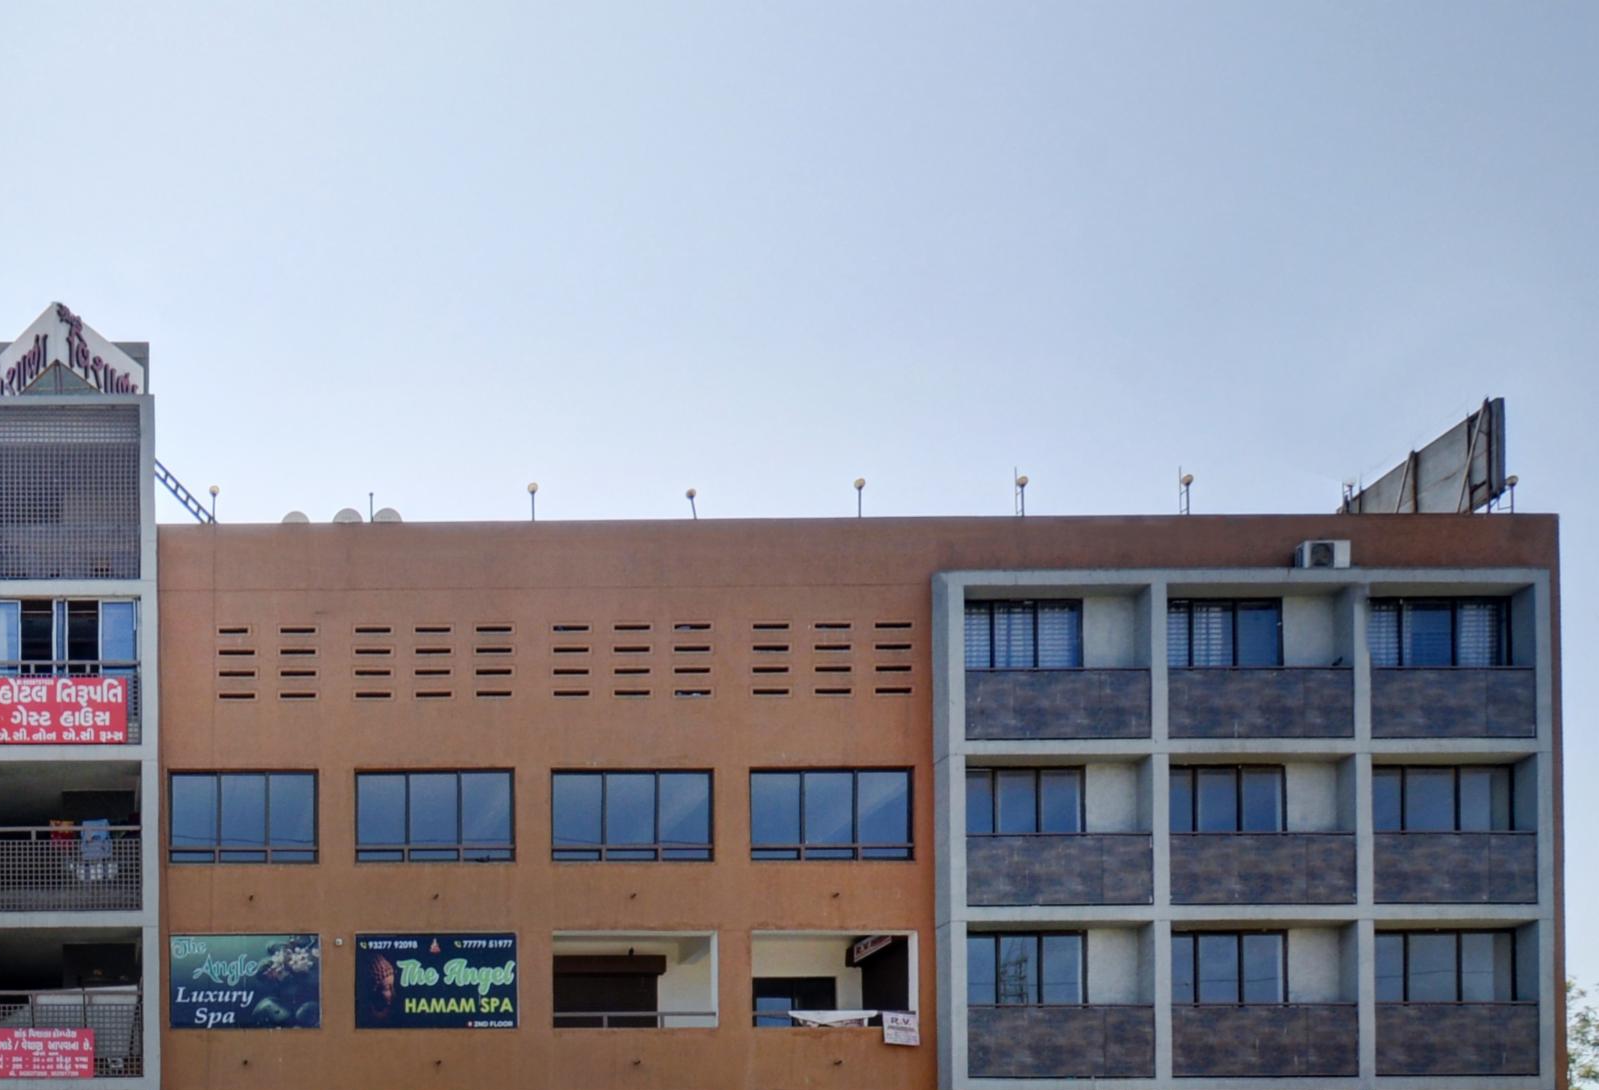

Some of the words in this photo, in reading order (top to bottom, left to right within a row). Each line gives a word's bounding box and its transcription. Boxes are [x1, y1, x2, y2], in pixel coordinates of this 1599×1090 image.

[56, 678, 123, 706] તિરૂપતિ
[10, 706, 52, 726] ગેસ્ટ
[59, 705, 111, 726] હાઉસ
[173, 938, 206, 959] The
[192, 953, 258, 986] Angle
[396, 959, 439, 987] The
[443, 958, 515, 995] Angel
[176, 986, 255, 1007] Luxury
[404, 998, 476, 1014] HAMAM
[479, 997, 514, 1014] SPA
[194, 1007, 236, 1028] Spa
